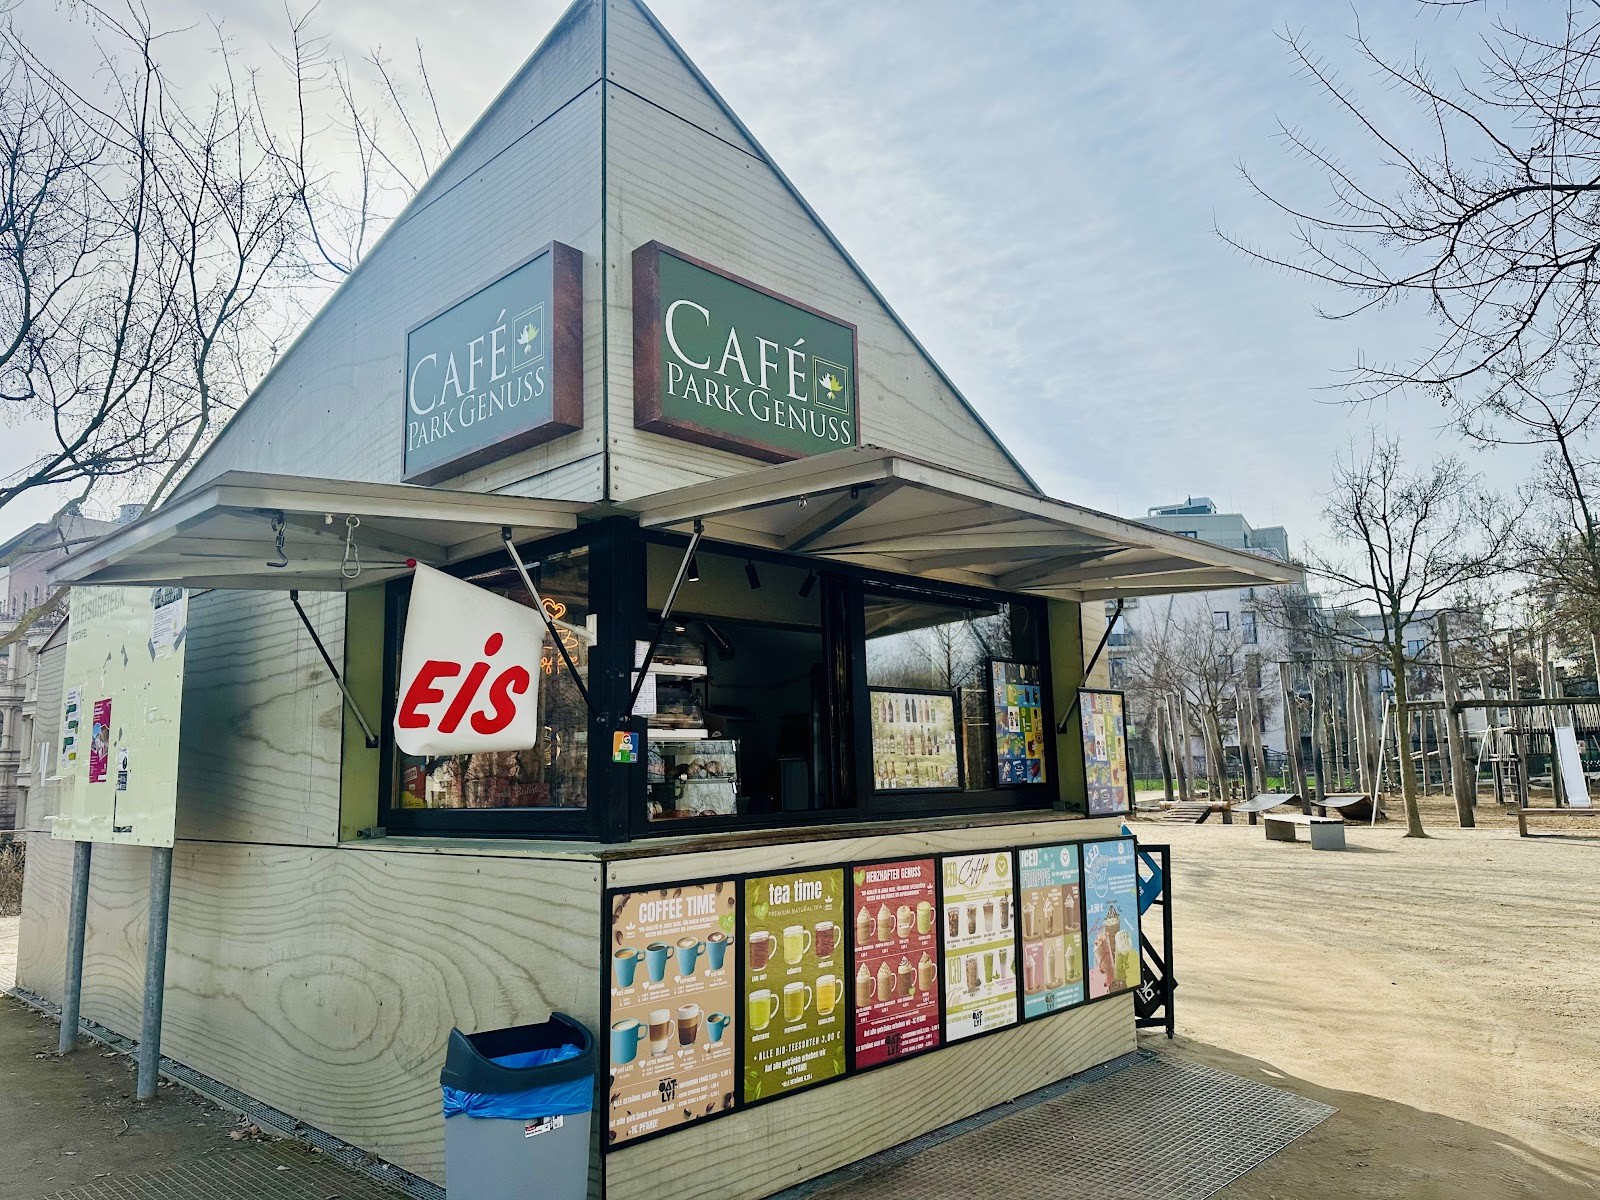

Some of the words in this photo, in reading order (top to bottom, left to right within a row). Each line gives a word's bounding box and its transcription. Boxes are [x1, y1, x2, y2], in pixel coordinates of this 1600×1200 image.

[410, 308, 507, 416] CAFÉ
[665, 298, 808, 402] CAFÉ
[408, 407, 456, 452] PARK
[459, 366, 545, 428] GENUSS
[666, 360, 744, 416] PARK
[748, 389, 851, 445] GENUSS
[73, 588, 125, 627] GLEISDREIECK
[1020, 849, 1039, 868] ICED
[866, 868, 900, 883] HERZHAFTER
[901, 866, 921, 879] GENUSS
[943, 861, 958, 888] ICED
[769, 883, 791, 906] tea
[794, 878, 823, 902] time
[639, 898, 684, 923] COFFEE
[686, 893, 716, 917] TIME
[758, 1049, 773, 1061] ALLE
[775, 1036, 820, 1057] BIO-TEESORTEN
